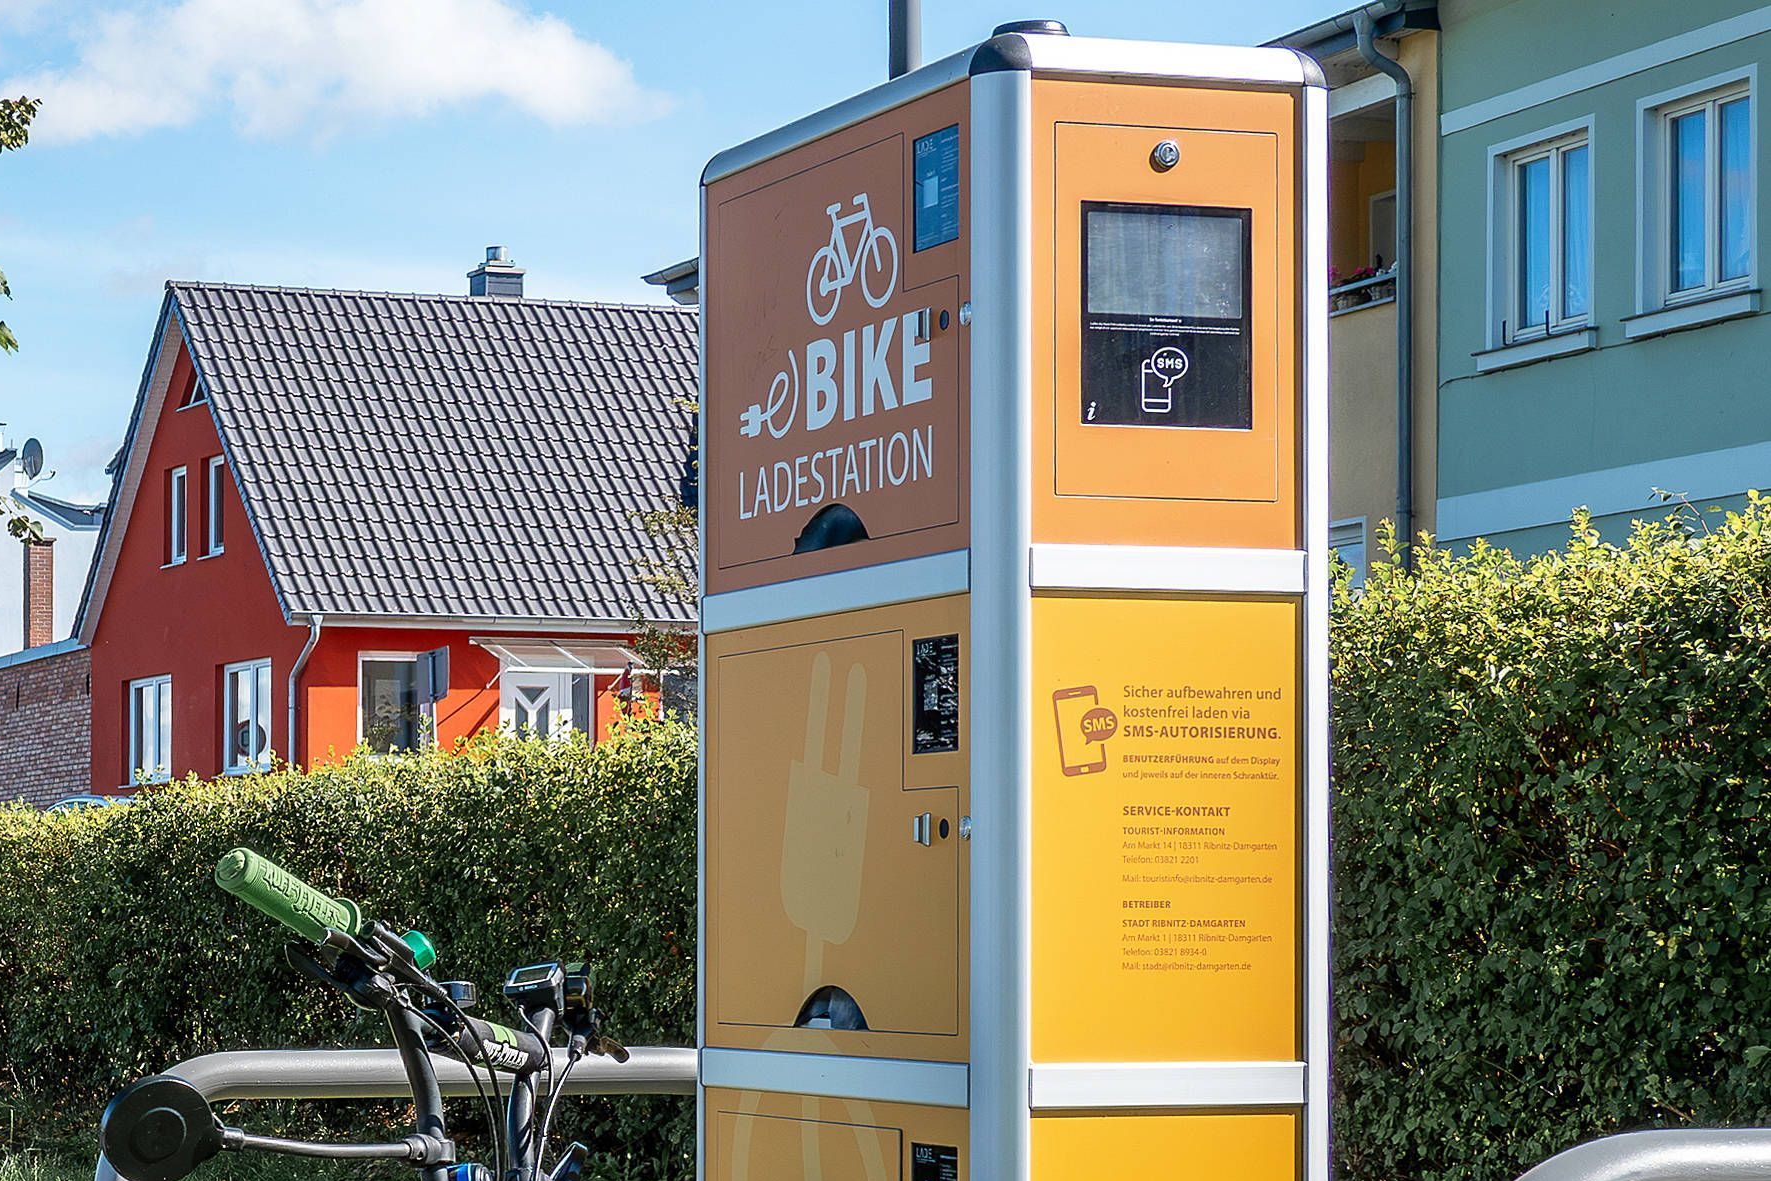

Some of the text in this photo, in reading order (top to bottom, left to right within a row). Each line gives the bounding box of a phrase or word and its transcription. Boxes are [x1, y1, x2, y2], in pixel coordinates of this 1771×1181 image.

[1156, 358, 1183, 370] SMS
[739, 424, 932, 520] LADESTATION
[1123, 685, 1282, 701] Sicher aufbewahren und
[1123, 704, 1250, 720] kostenfrei laden via
[1083, 715, 1115, 733] SMS
[1123, 725, 1282, 740] SMS-AUTORISIERUNG.
[1123, 753, 1281, 768] BENUTZERFÜHRUNG auf dem Display
[1122, 769, 1139, 779] und
[1140, 770, 1169, 781] jeweils
[1170, 770, 1184, 780] auf
[1184, 770, 1199, 780] der
[1199, 771, 1232, 781] inneren
[1122, 805, 1231, 817] SERVICE-KONTAKT
[1122, 826, 1226, 836] TOURIST-INFORMATION
[1137, 841, 1161, 850] Markt
[1122, 900, 1172, 909] BETREIBER
[1122, 919, 1246, 930] STADT RIBNITZ-DAMGARTEN
[1137, 934, 1161, 943] Markt
